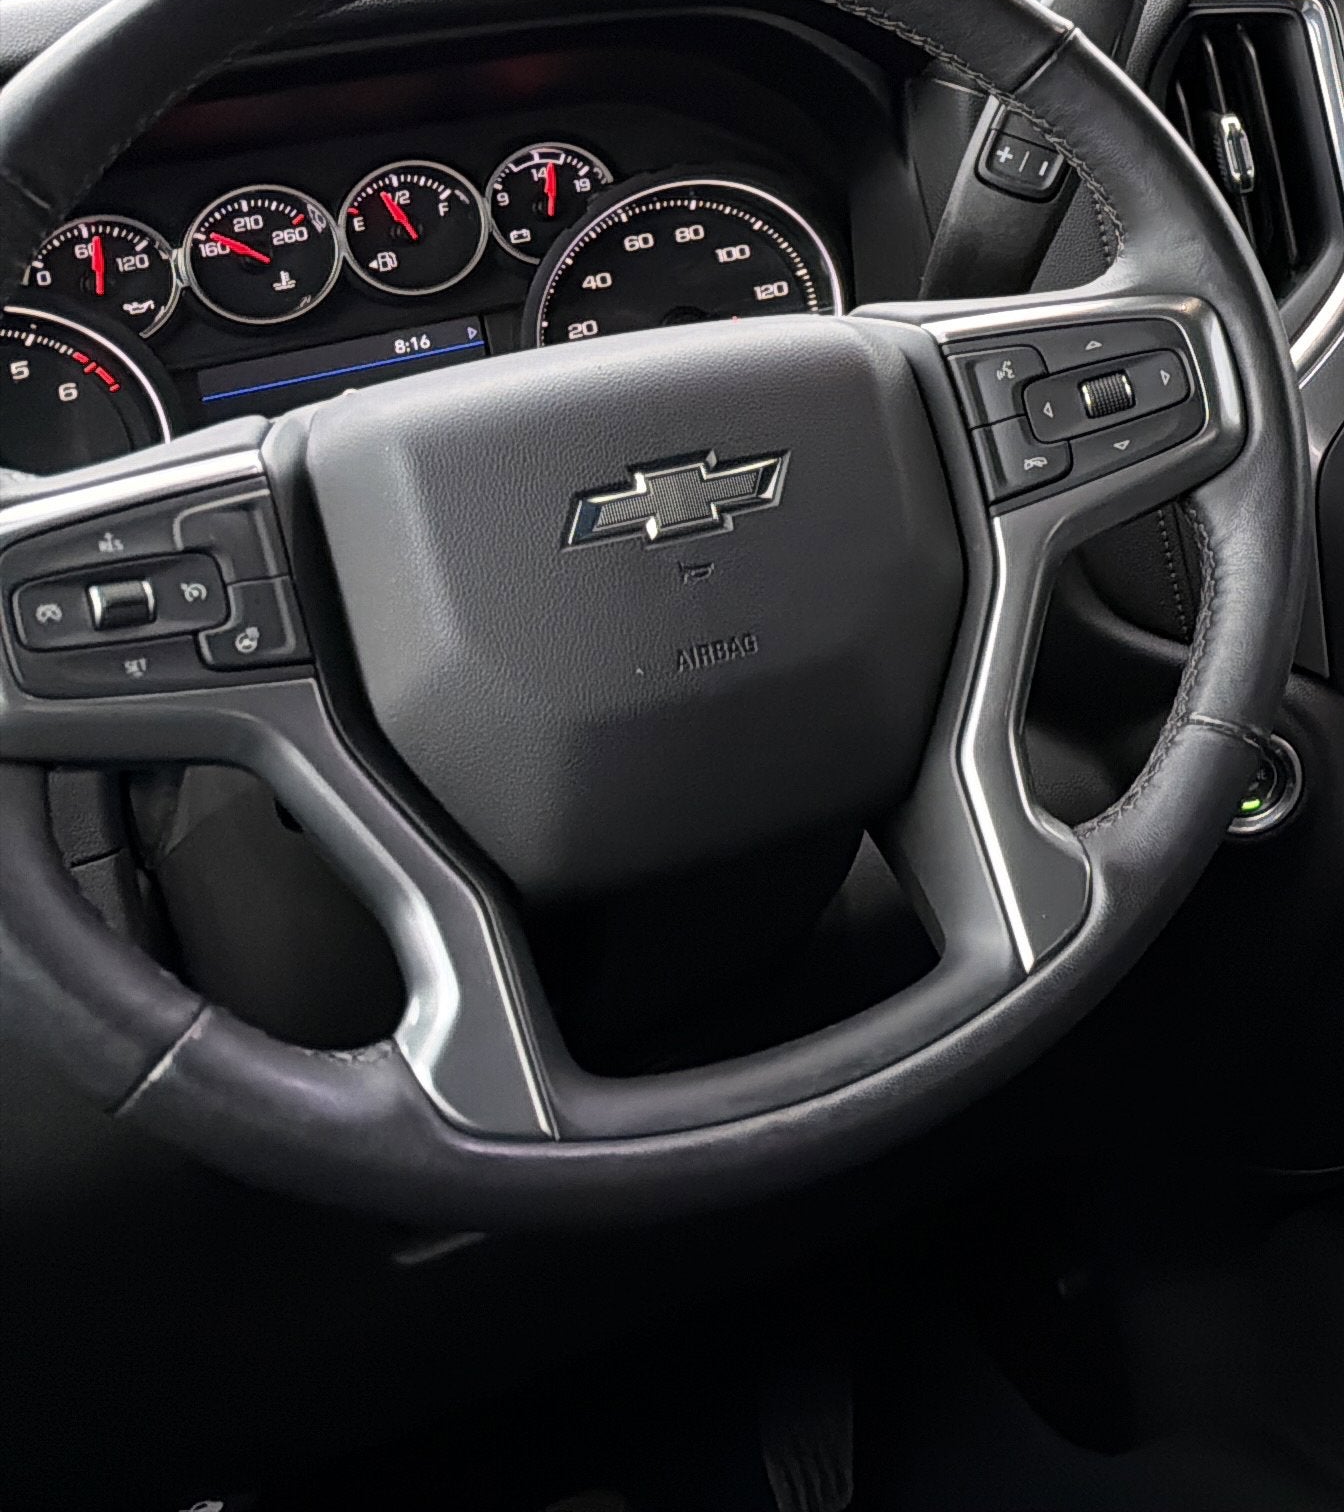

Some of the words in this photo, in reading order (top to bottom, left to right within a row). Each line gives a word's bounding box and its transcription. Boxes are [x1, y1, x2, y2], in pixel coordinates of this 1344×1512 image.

[573, 178, 591, 192] 19
[497, 192, 510, 206] 9
[438, 202, 449, 217] F
[233, 214, 264, 233] 210
[353, 216, 365, 232] E
[272, 227, 308, 246] 260
[623, 233, 655, 252] 60
[674, 224, 705, 243] 80
[199, 241, 230, 258] 160
[715, 244, 751, 263] 100
[116, 254, 149, 272] 120
[36, 270, 52, 286] 0
[582, 272, 612, 290] 40
[754, 281, 789, 301] 120
[568, 319, 598, 340] 20
[394, 334, 431, 354] 8:16
[10, 360, 30, 381] 5
[58, 382, 78, 402] 6
[677, 633, 758, 673] AIRBAG
